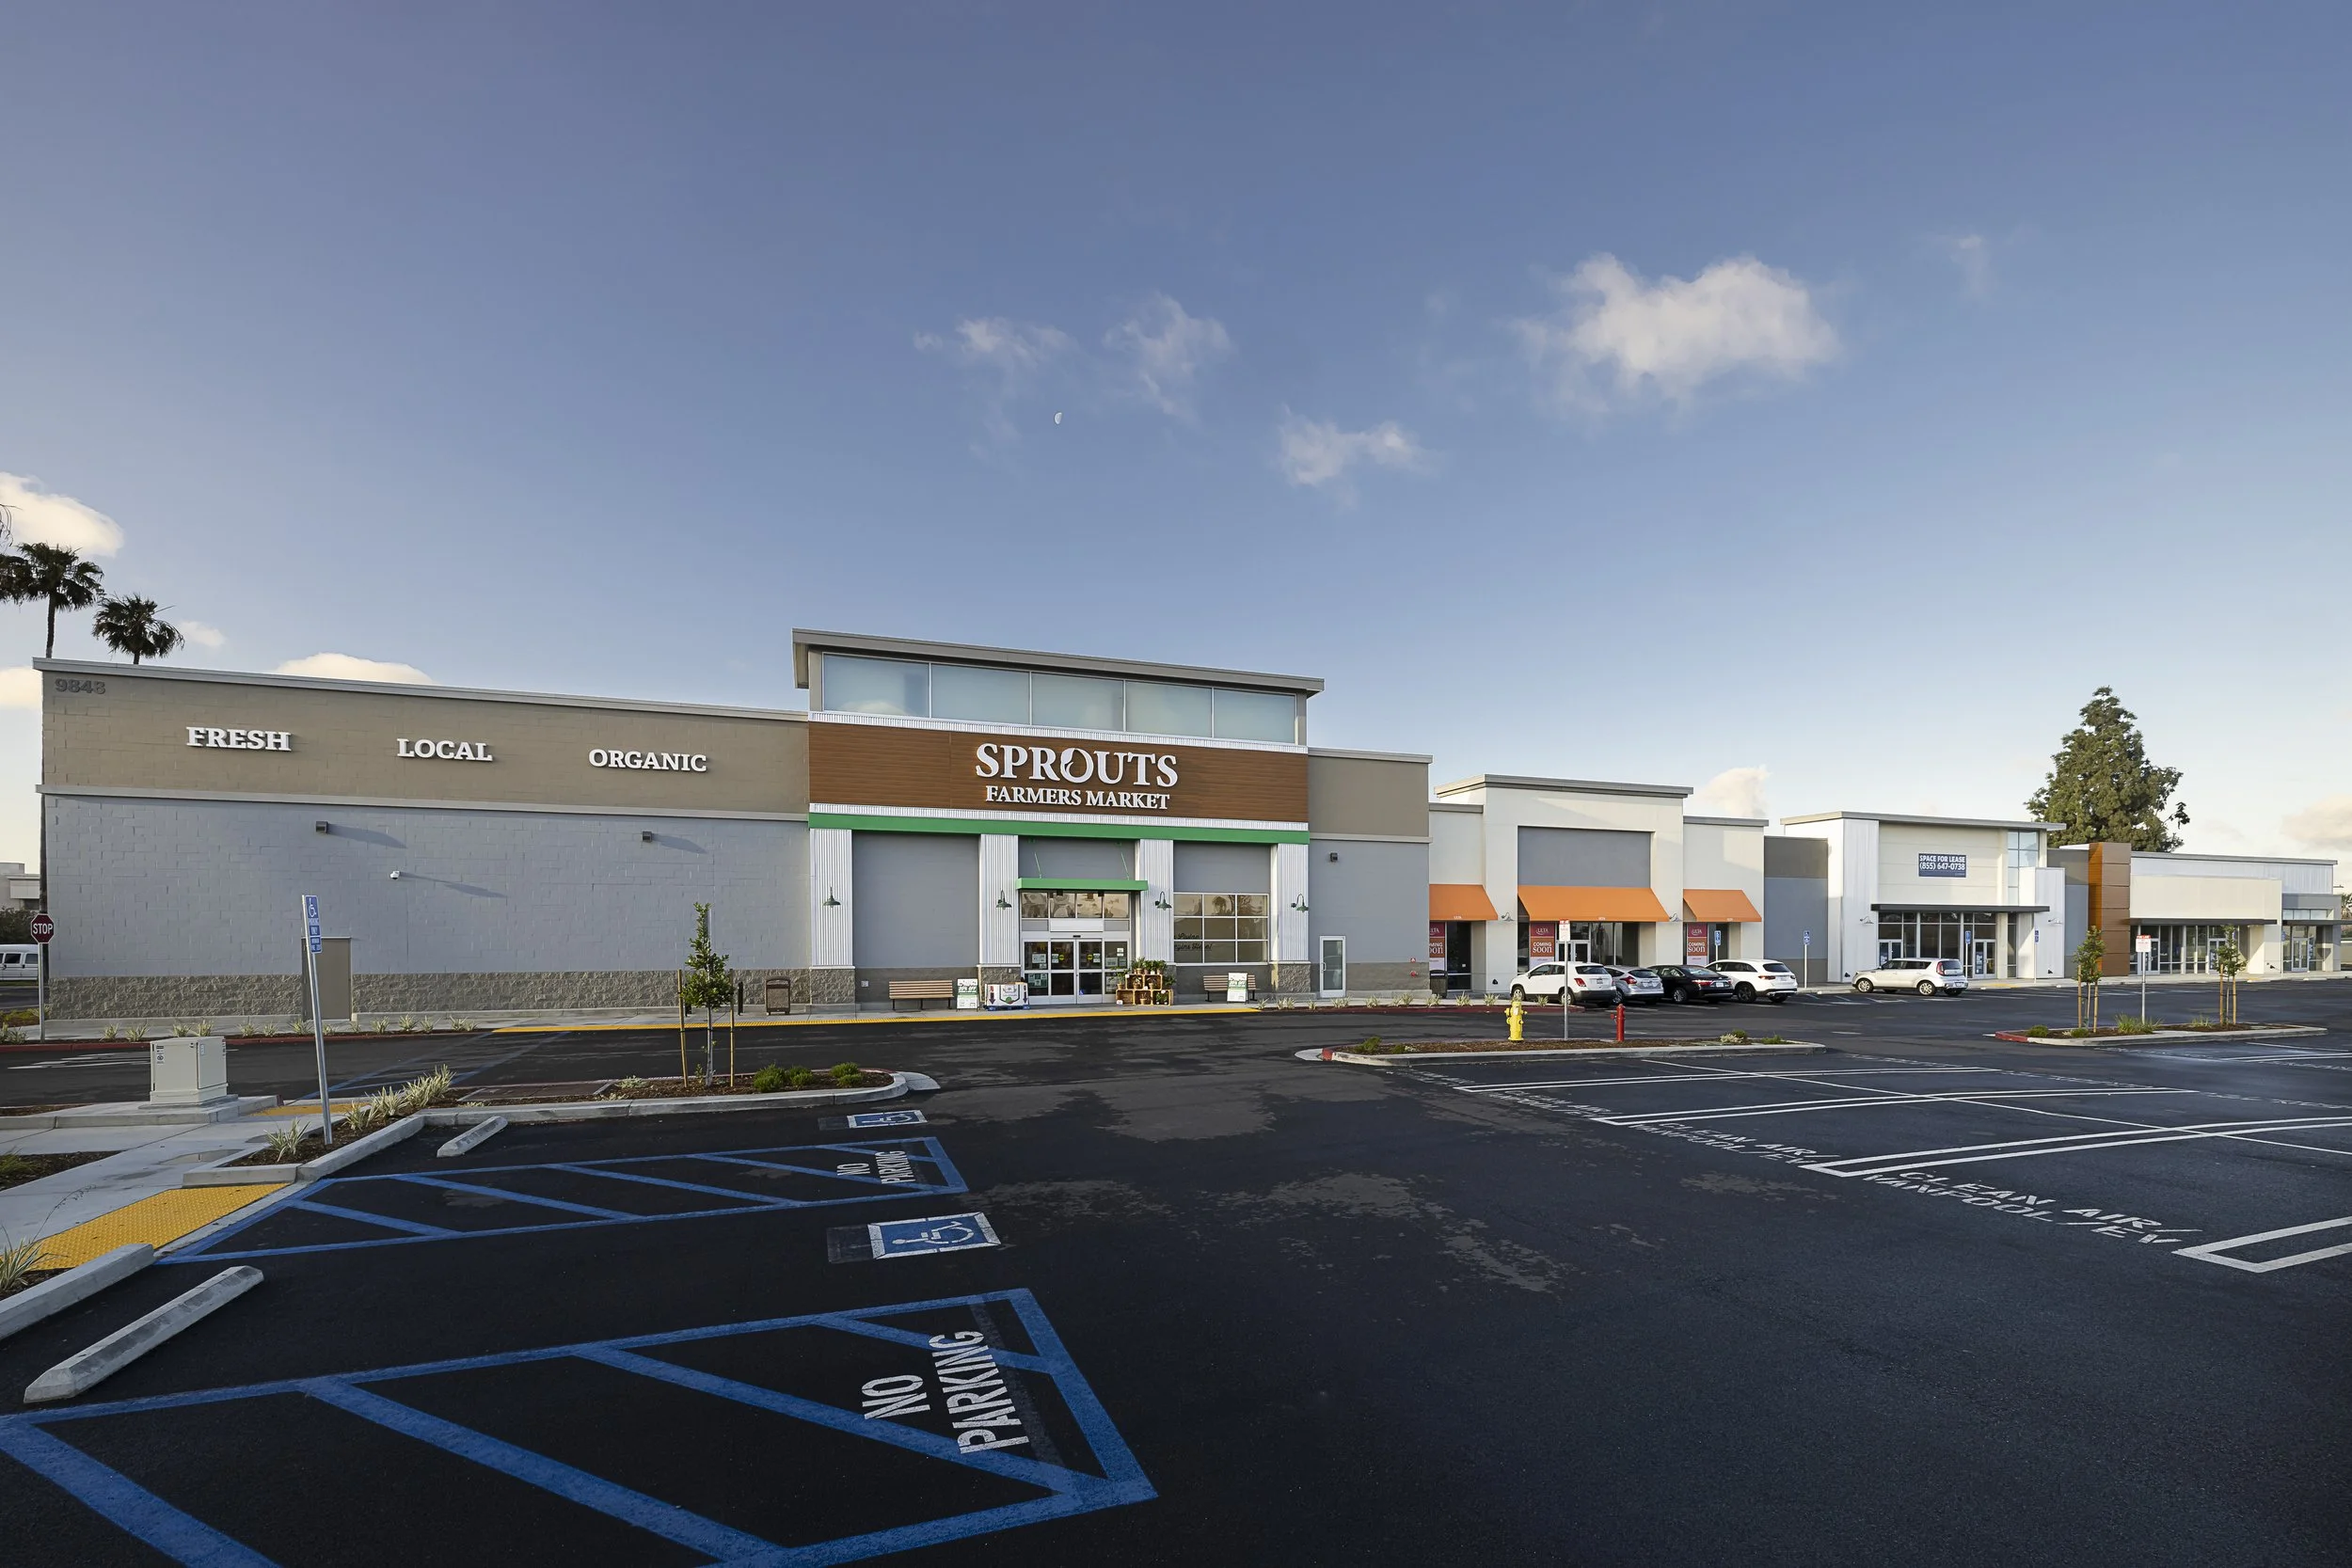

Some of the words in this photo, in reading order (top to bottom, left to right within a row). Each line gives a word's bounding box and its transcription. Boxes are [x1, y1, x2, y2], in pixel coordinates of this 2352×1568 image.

[186, 726, 292, 752] FRESH
[396, 737, 493, 762] LOCAL
[588, 749, 707, 772] ORGANIC
[975, 742, 1179, 788] SPROUTS
[985, 784, 1082, 806] FARMERS
[1085, 789, 1170, 810] MARKET
[1919, 854, 1937, 863] SPACE
[1919, 862, 1936, 870] (855)
[1936, 863, 1965, 871] 647-0738
[32, 923, 54, 934] STOP
[1659, 1122, 1757, 1143] CLEAN
[836, 1163, 870, 1176] NO
[875, 1150, 916, 1184] PARKING
[1899, 1171, 2057, 1206] CLEAN
[861, 1374, 931, 1420] NO
[928, 1331, 1030, 1454] PARKING
